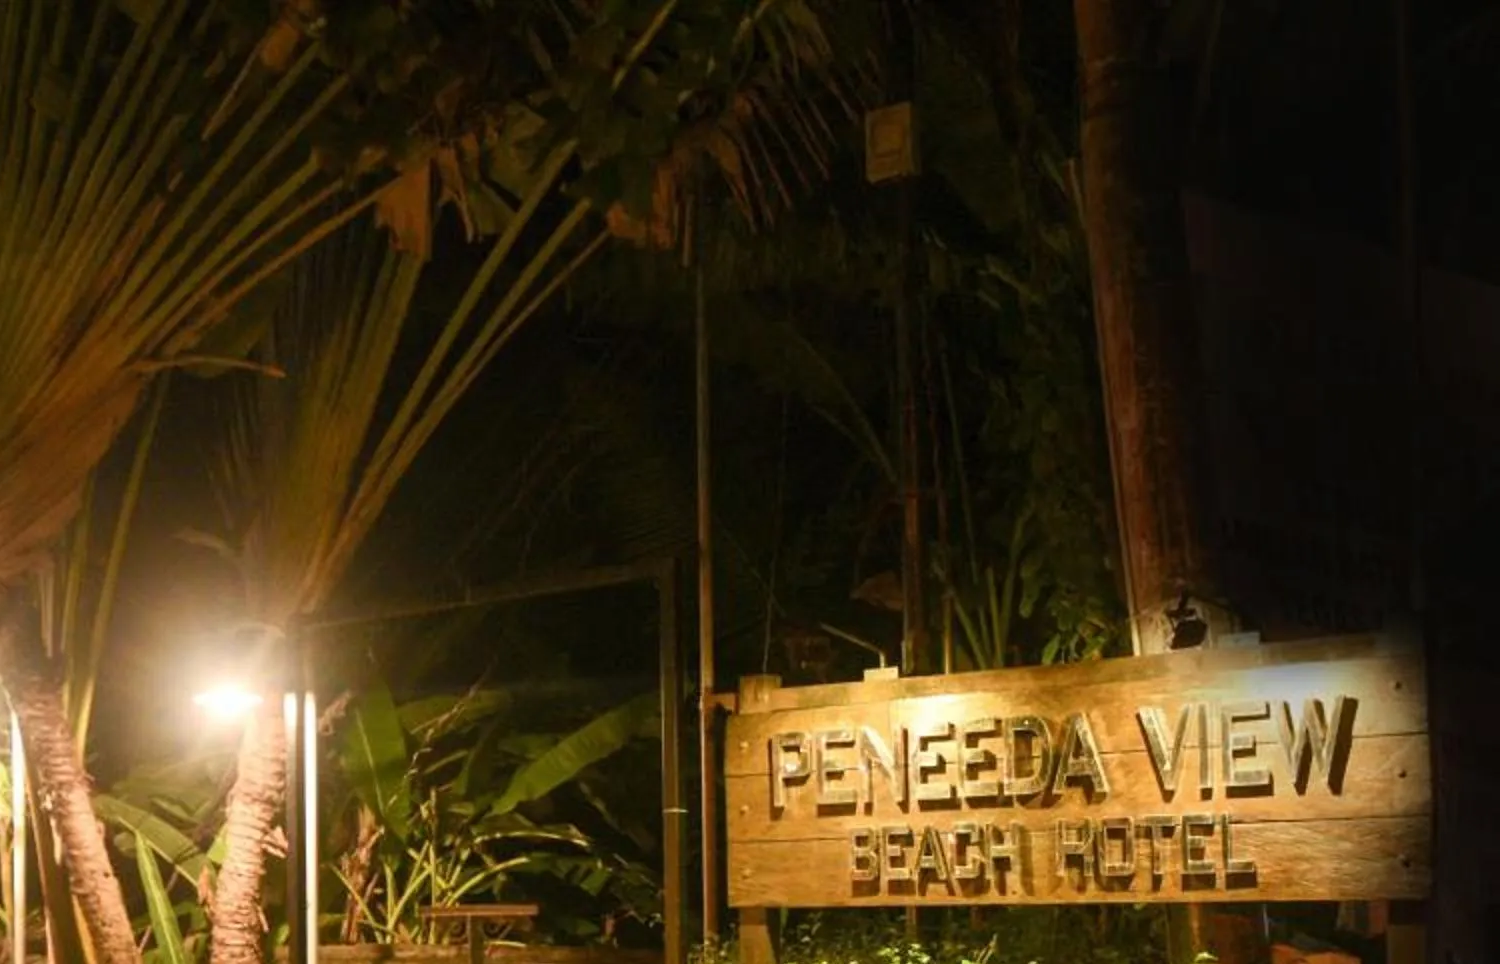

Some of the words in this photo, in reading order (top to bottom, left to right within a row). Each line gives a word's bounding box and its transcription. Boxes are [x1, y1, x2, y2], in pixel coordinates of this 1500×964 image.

[768, 712, 1111, 817] PENEEDA
[1136, 696, 1358, 802] VIEW
[851, 823, 1031, 895] BEACH
[1056, 814, 1257, 891] HOTEL
